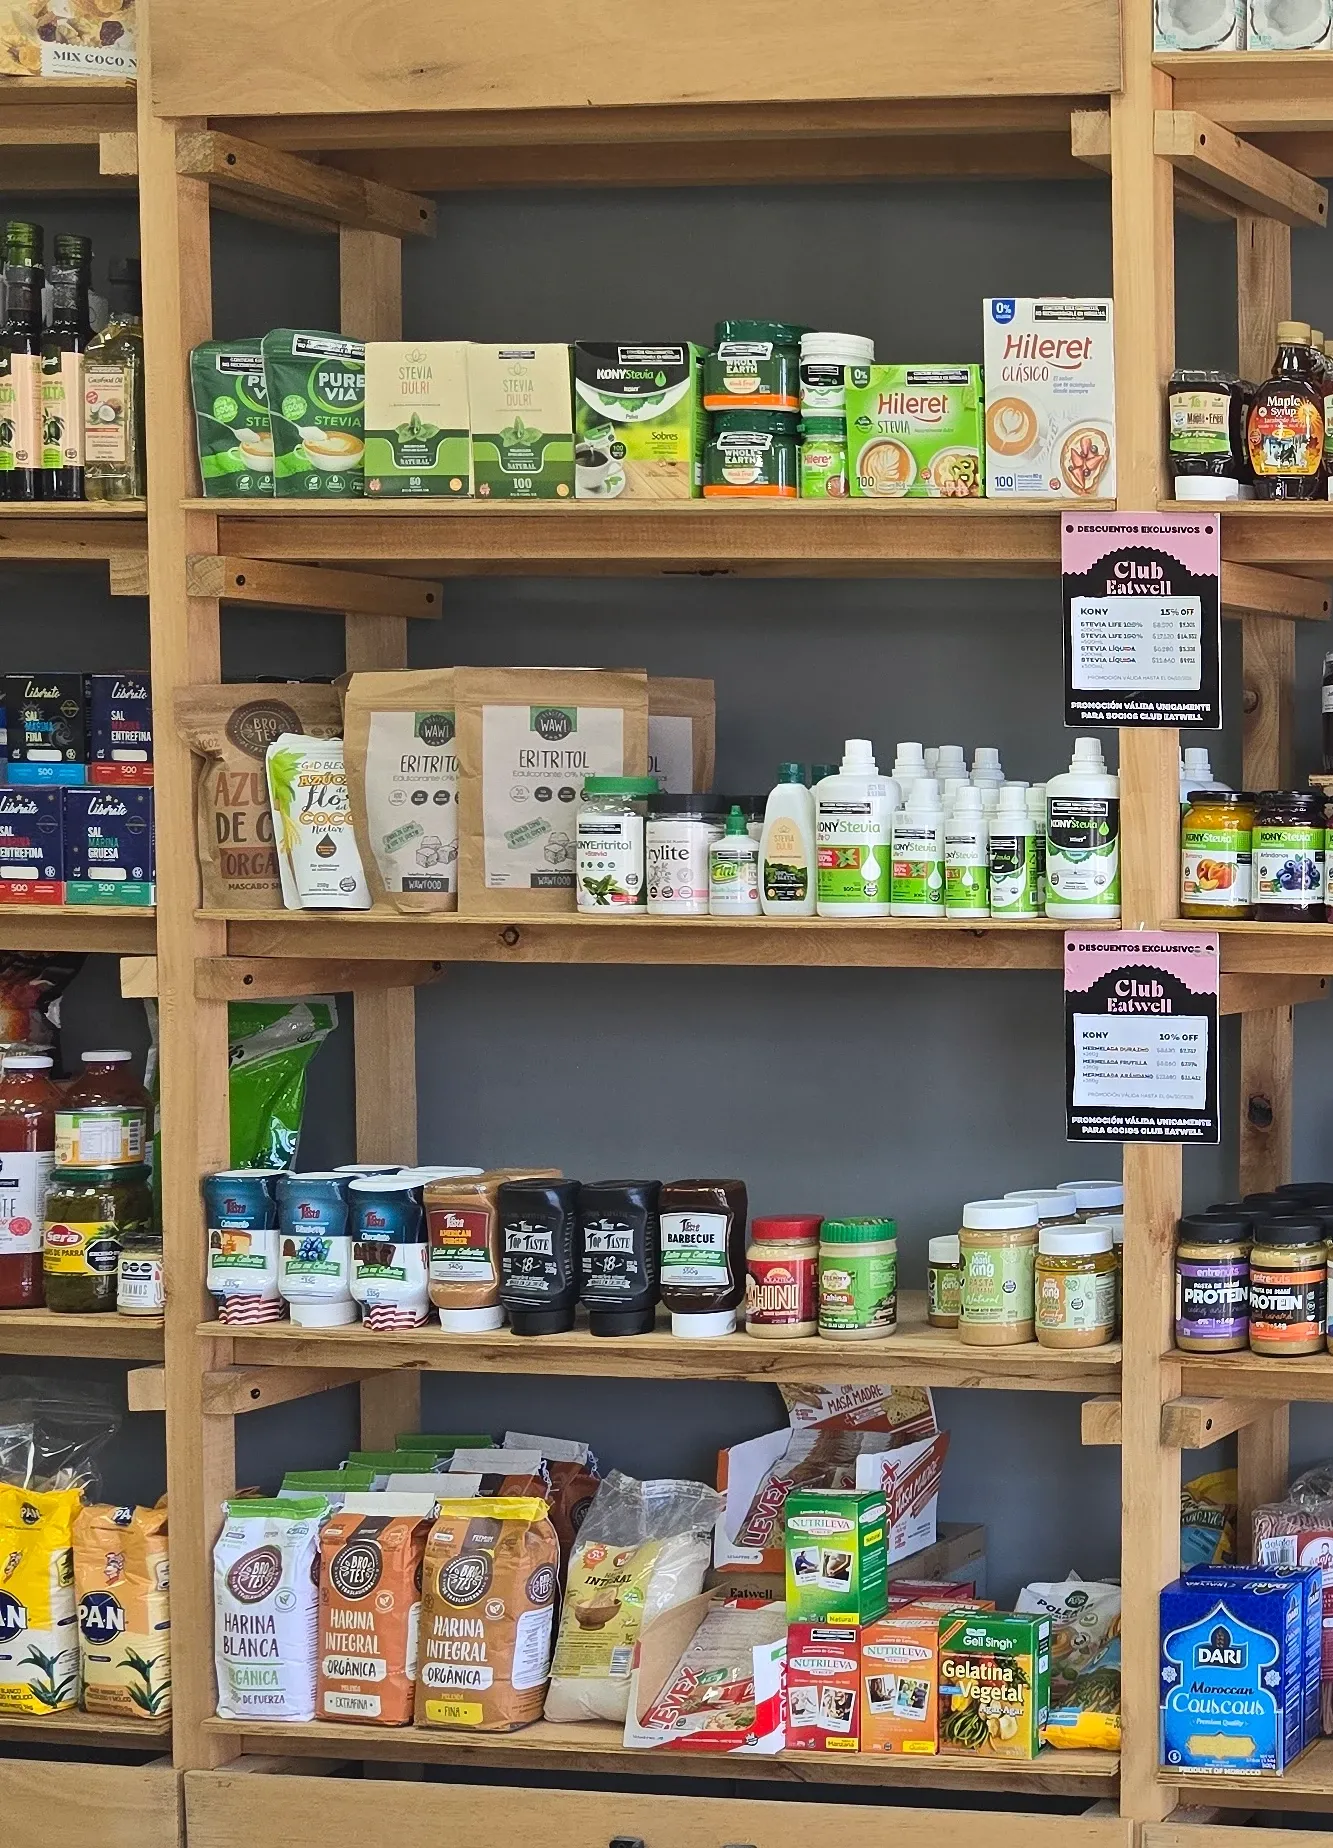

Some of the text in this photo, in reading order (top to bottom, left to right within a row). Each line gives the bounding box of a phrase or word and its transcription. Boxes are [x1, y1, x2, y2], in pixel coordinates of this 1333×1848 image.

[53, 50, 124, 66] MIX COCO
[1003, 334, 1092, 360] Hileret
[318, 372, 365, 388] PURE
[398, 367, 433, 380] STEVIA
[1002, 364, 1049, 383] CLÁSICO
[324, 388, 357, 401] VIA
[401, 380, 429, 395] DULRI
[877, 392, 949, 416] Hileret
[1267, 396, 1300, 407] Maple
[1271, 408, 1296, 416] Syrup
[314, 415, 361, 427] STEVIA
[877, 420, 911, 435] STEVIA
[1078, 526, 1200, 534] DESCUENTOS EXCLUSIVOS
[1114, 561, 1163, 579] Club
[1107, 580, 1171, 595] Eatwell
[111, 711, 125, 721] SAL
[112, 731, 151, 742] ENTREFINA
[519, 748, 590, 770] ERITRITOL
[1115, 980, 1163, 997] Club
[1107, 998, 1172, 1013] Eatwell
[667, 1233, 715, 1245] BARBECUE
[1184, 1285, 1251, 1305] PROTEIN
[791, 1518, 849, 1530] NUTRILEVA
[224, 1613, 276, 1635] HARINA
[434, 1615, 484, 1638] HARINA
[829, 1615, 854, 1623] Natural
[223, 1636, 279, 1658] BLANCA
[427, 1640, 488, 1662] INTEGRAL
[1197, 1647, 1243, 1666] DARI
[794, 1659, 852, 1670] NUTRILEVA
[942, 1660, 1013, 1682] Gelatina
[428, 1665, 481, 1685] ORGÁNICA
[959, 1680, 1024, 1704] Vegetal
[1190, 1681, 1255, 1696] Moroccan
[444, 1706, 462, 1718] FINA
[1178, 1766, 1262, 1777] PRODUCT OF MOROCCO
